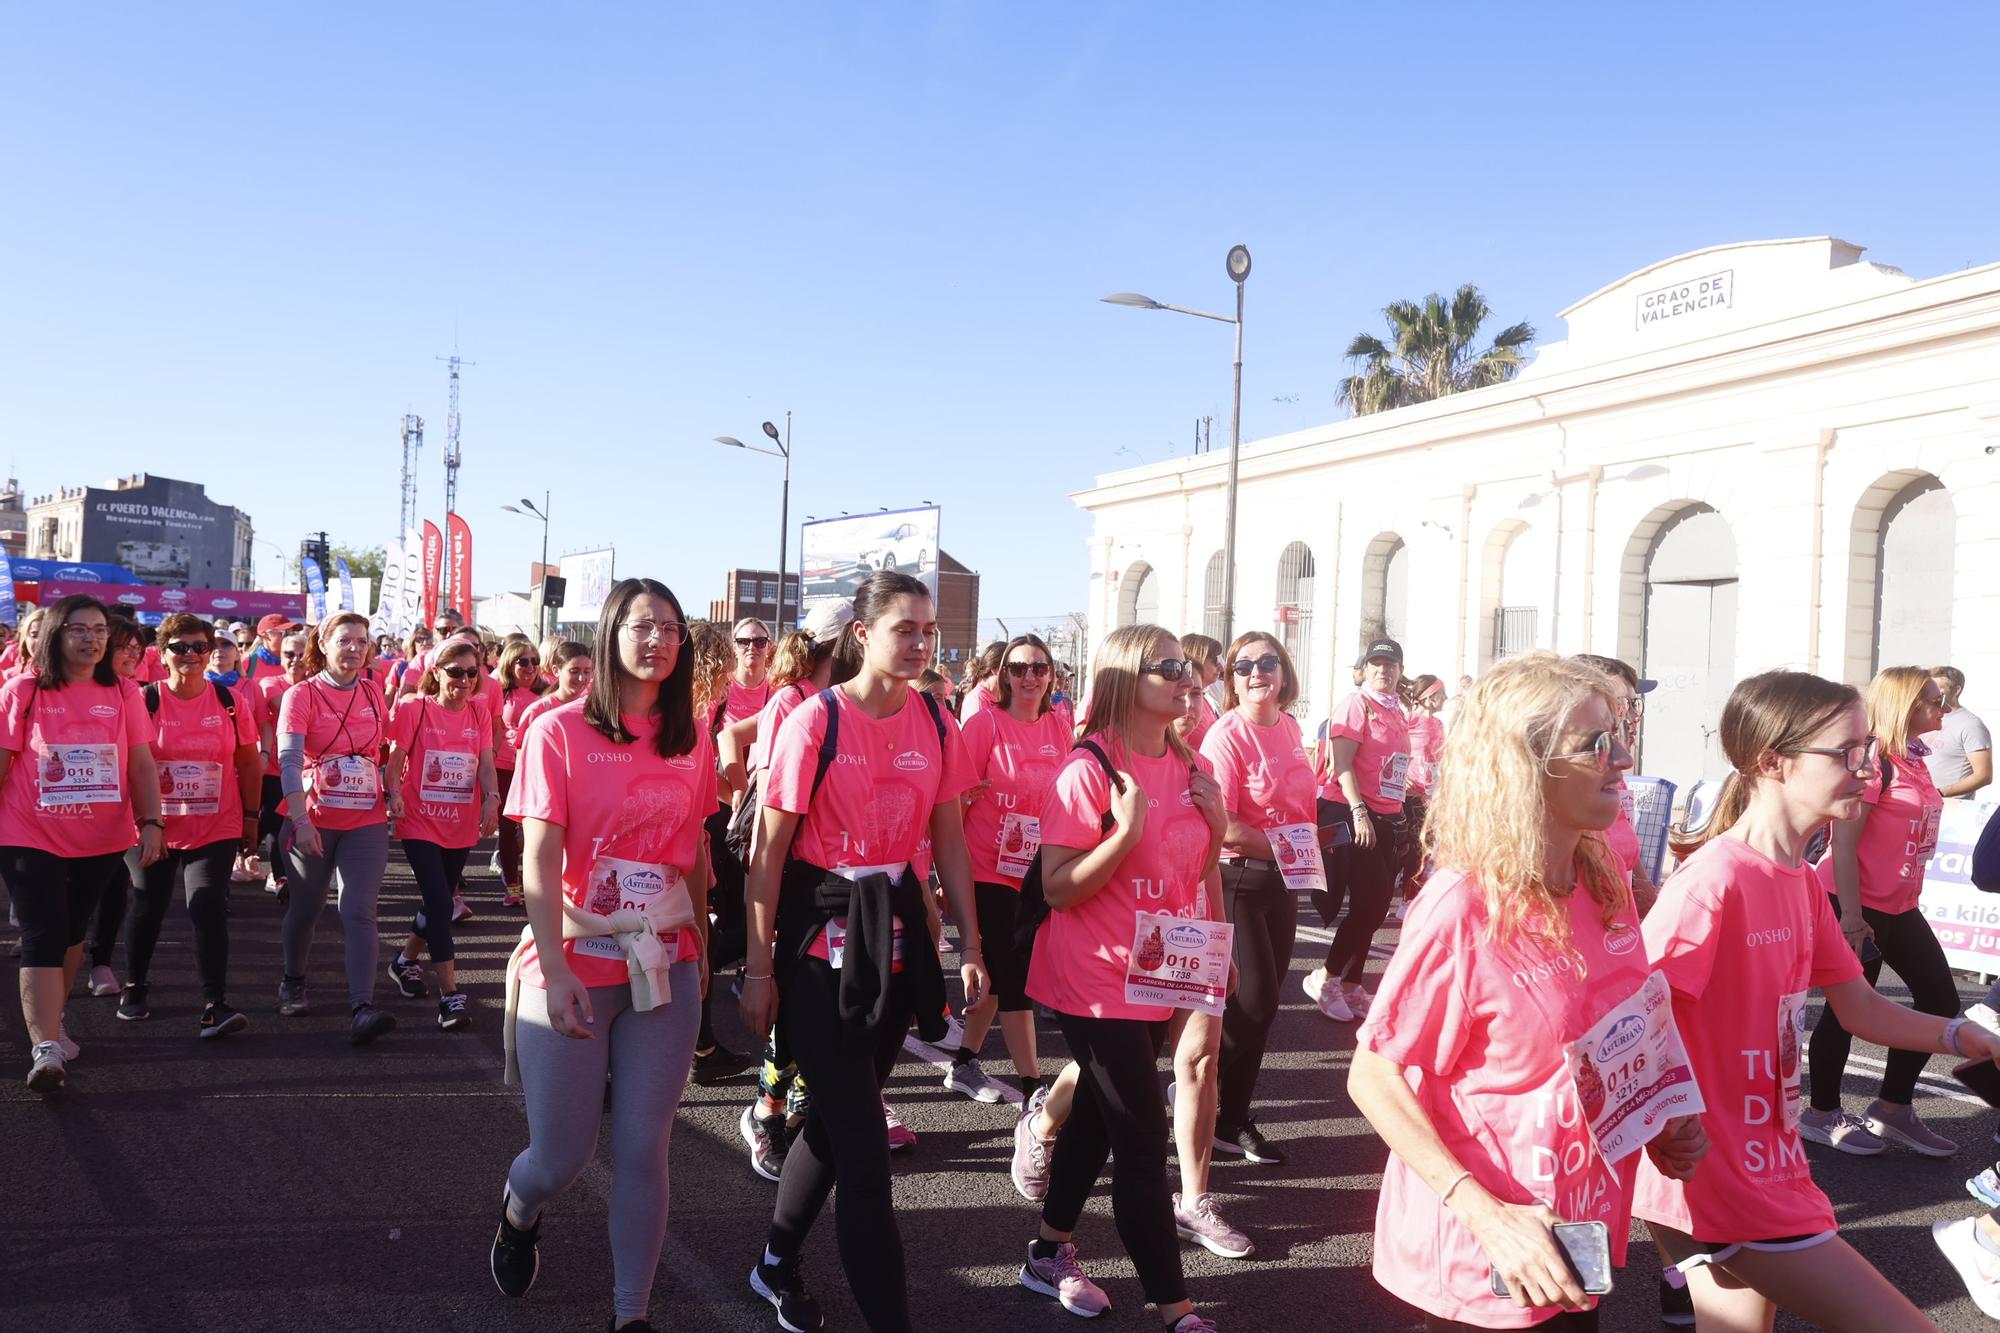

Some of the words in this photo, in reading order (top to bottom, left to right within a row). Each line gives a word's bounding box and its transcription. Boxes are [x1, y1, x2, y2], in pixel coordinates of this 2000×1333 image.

[1645, 288, 1690, 308] GRAO
[1700, 278, 1723, 294] DE
[1642, 293, 1725, 324] VALENCIA
[96, 503, 108, 512] EL
[110, 503, 149, 515] PUERTO
[587, 752, 633, 763] OYSHO
[67, 767, 94, 777] 016
[443, 772, 463, 780] 016
[343, 776, 364, 785] 016
[34, 800, 92, 815] SUMA
[997, 792, 1017, 809] TU
[420, 803, 459, 818] SUMA
[1024, 841, 1037, 851] 01
[1296, 848, 1316, 858] 016
[1132, 878, 1165, 900] TU
[1936, 905, 1948, 918] a
[1168, 931, 1204, 944] ASTURIANA
[1747, 926, 1792, 947] OYSHO
[586, 939, 621, 953] OYSHO
[1166, 954, 1200, 970] 016
[1171, 970, 1191, 980] 1738
[1512, 955, 1571, 988] OYSHO
[1138, 977, 1166, 987] CARRERA
[1184, 984, 1205, 992] MUJER
[1133, 990, 1164, 1000] OYSHO
[1600, 1023, 1643, 1060] ASTURIANA
[1607, 1053, 1646, 1092] 016
[1615, 1079, 1639, 1104] 3213
[1535, 1090, 1579, 1129] TU
